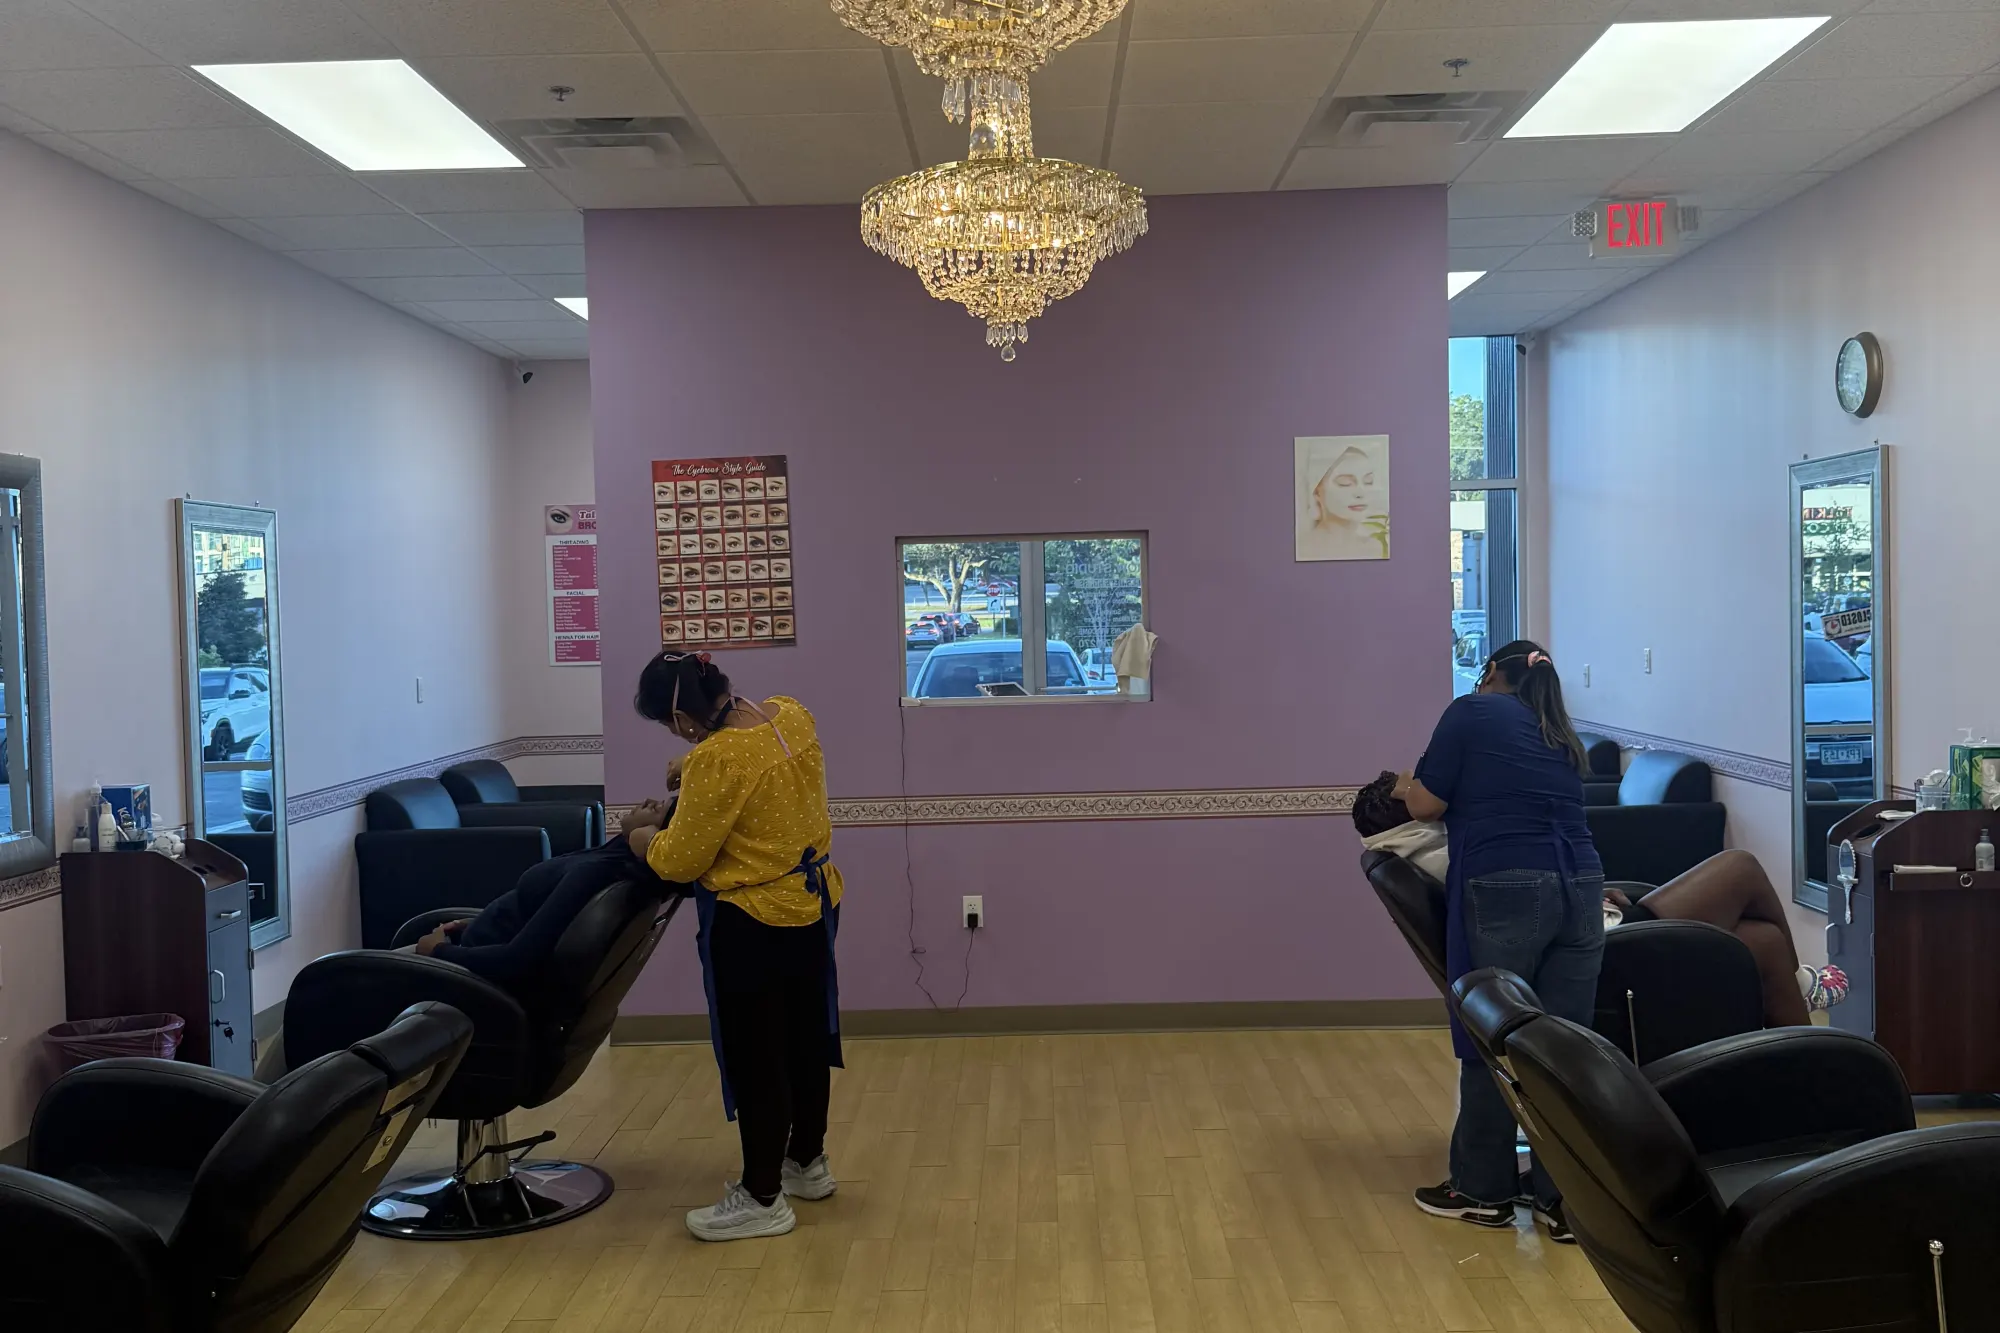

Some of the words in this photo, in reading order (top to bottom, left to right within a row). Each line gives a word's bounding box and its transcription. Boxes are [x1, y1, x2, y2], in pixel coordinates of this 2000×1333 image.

[1607, 202, 1667, 249] EXIT
[672, 464, 684, 476] The
[687, 464, 720, 477] Eyebrow
[722, 460, 743, 475] Style
[745, 462, 766, 474] Guide
